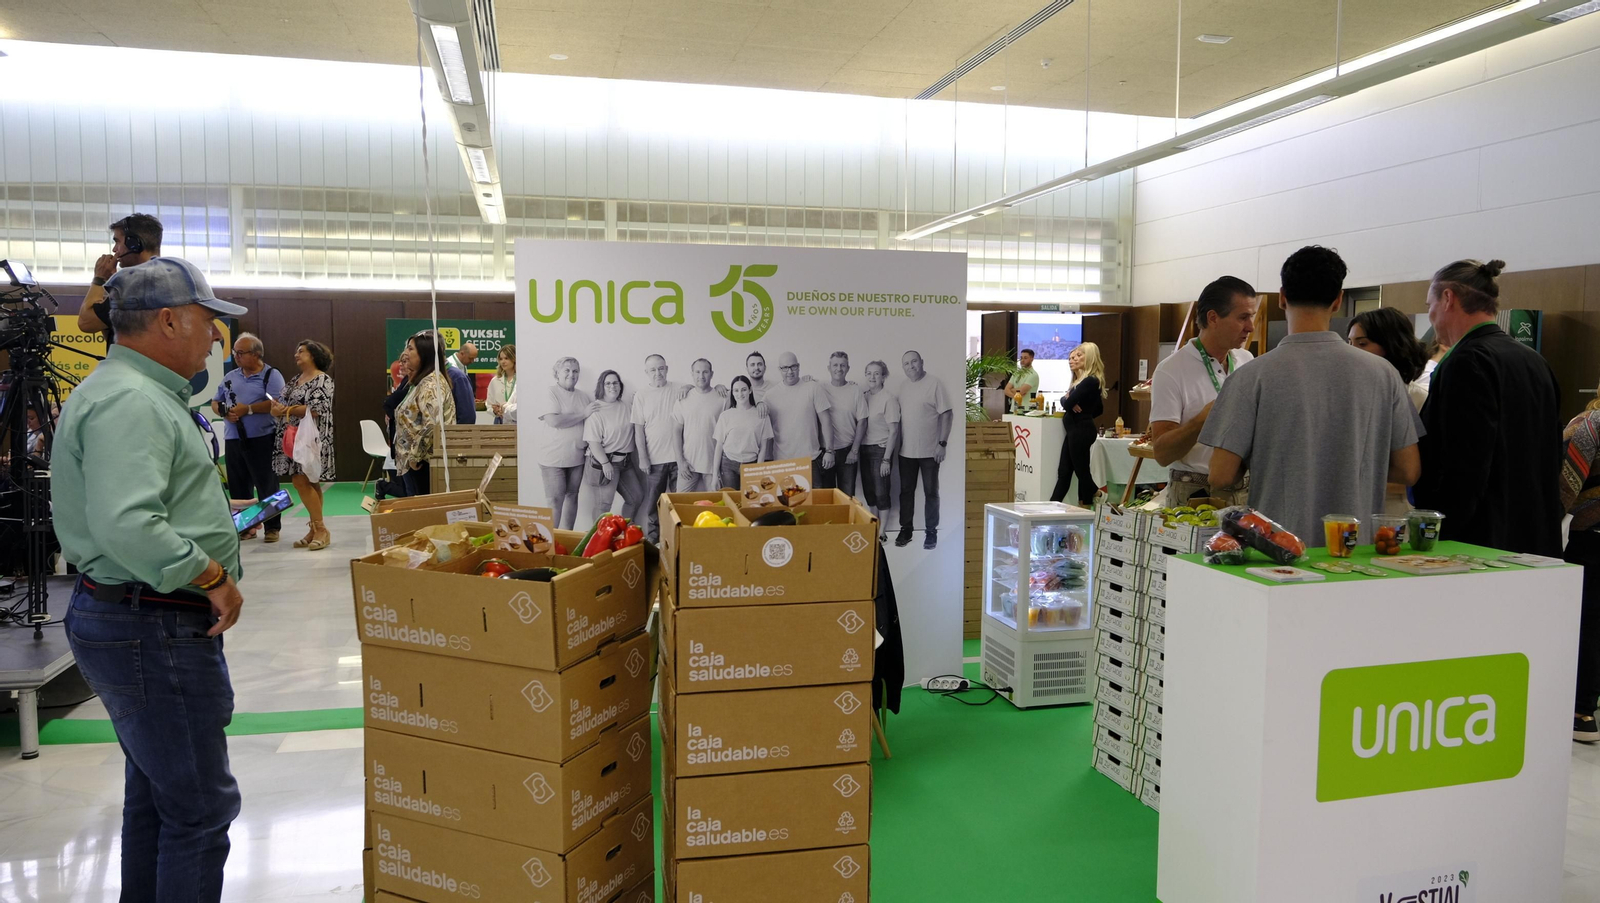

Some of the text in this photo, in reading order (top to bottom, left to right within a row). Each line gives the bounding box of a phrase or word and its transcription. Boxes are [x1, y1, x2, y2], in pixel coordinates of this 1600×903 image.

[786, 290, 960, 304] DUEÑOS DE NUESTRO FUTURO.
[786, 306, 915, 317] WE OWN OUR FUTURE.
[756, 306, 770, 333] YEARS
[74, 361, 90, 370] de
[1014, 460, 1034, 474] alma
[690, 562, 702, 574] la
[688, 573, 721, 587] caja
[361, 586, 376, 603] la
[362, 604, 398, 623] caja
[566, 607, 576, 621] la
[566, 614, 588, 636] caja
[690, 640, 703, 654] la
[689, 652, 724, 668] caja
[369, 676, 381, 691] la
[370, 691, 399, 708] caja
[570, 698, 579, 713] la
[570, 705, 592, 726] caja
[688, 723, 702, 737] la
[687, 735, 722, 750] caja
[373, 760, 385, 775] la
[374, 777, 402, 793] caja
[571, 789, 580, 803] la
[571, 794, 593, 816] caja
[687, 806, 701, 820] la
[377, 824, 390, 842] la
[686, 818, 721, 833] caja
[377, 843, 411, 864] caja
[577, 876, 586, 890] la
[1430, 874, 1454, 884] 2023
